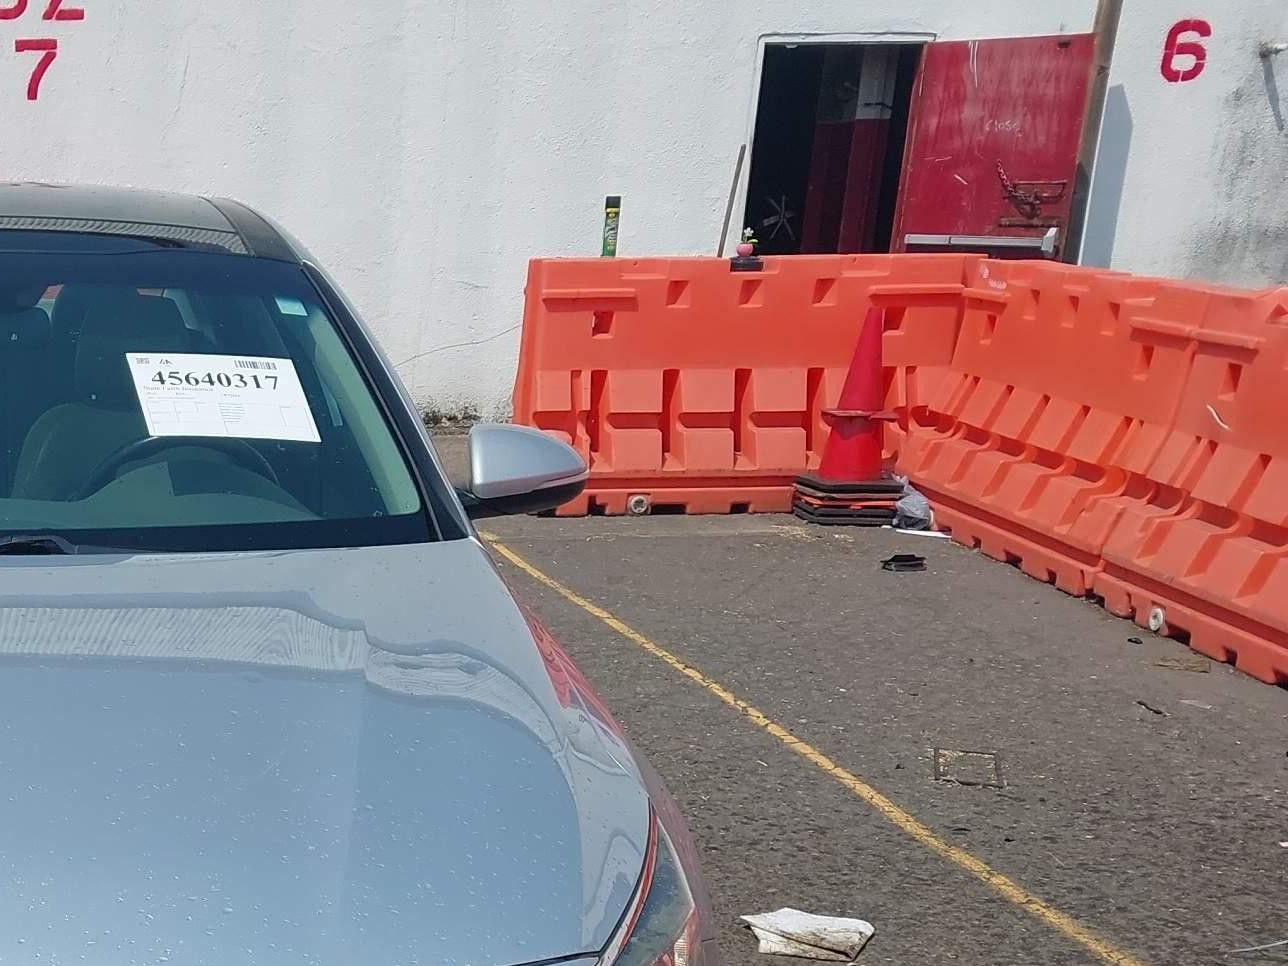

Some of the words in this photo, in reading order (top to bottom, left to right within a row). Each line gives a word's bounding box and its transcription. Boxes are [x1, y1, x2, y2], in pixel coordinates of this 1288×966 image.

[15, 38, 57, 100] 7
[1161, 19, 1211, 82] 6
[152, 371, 278, 390] 45640317
